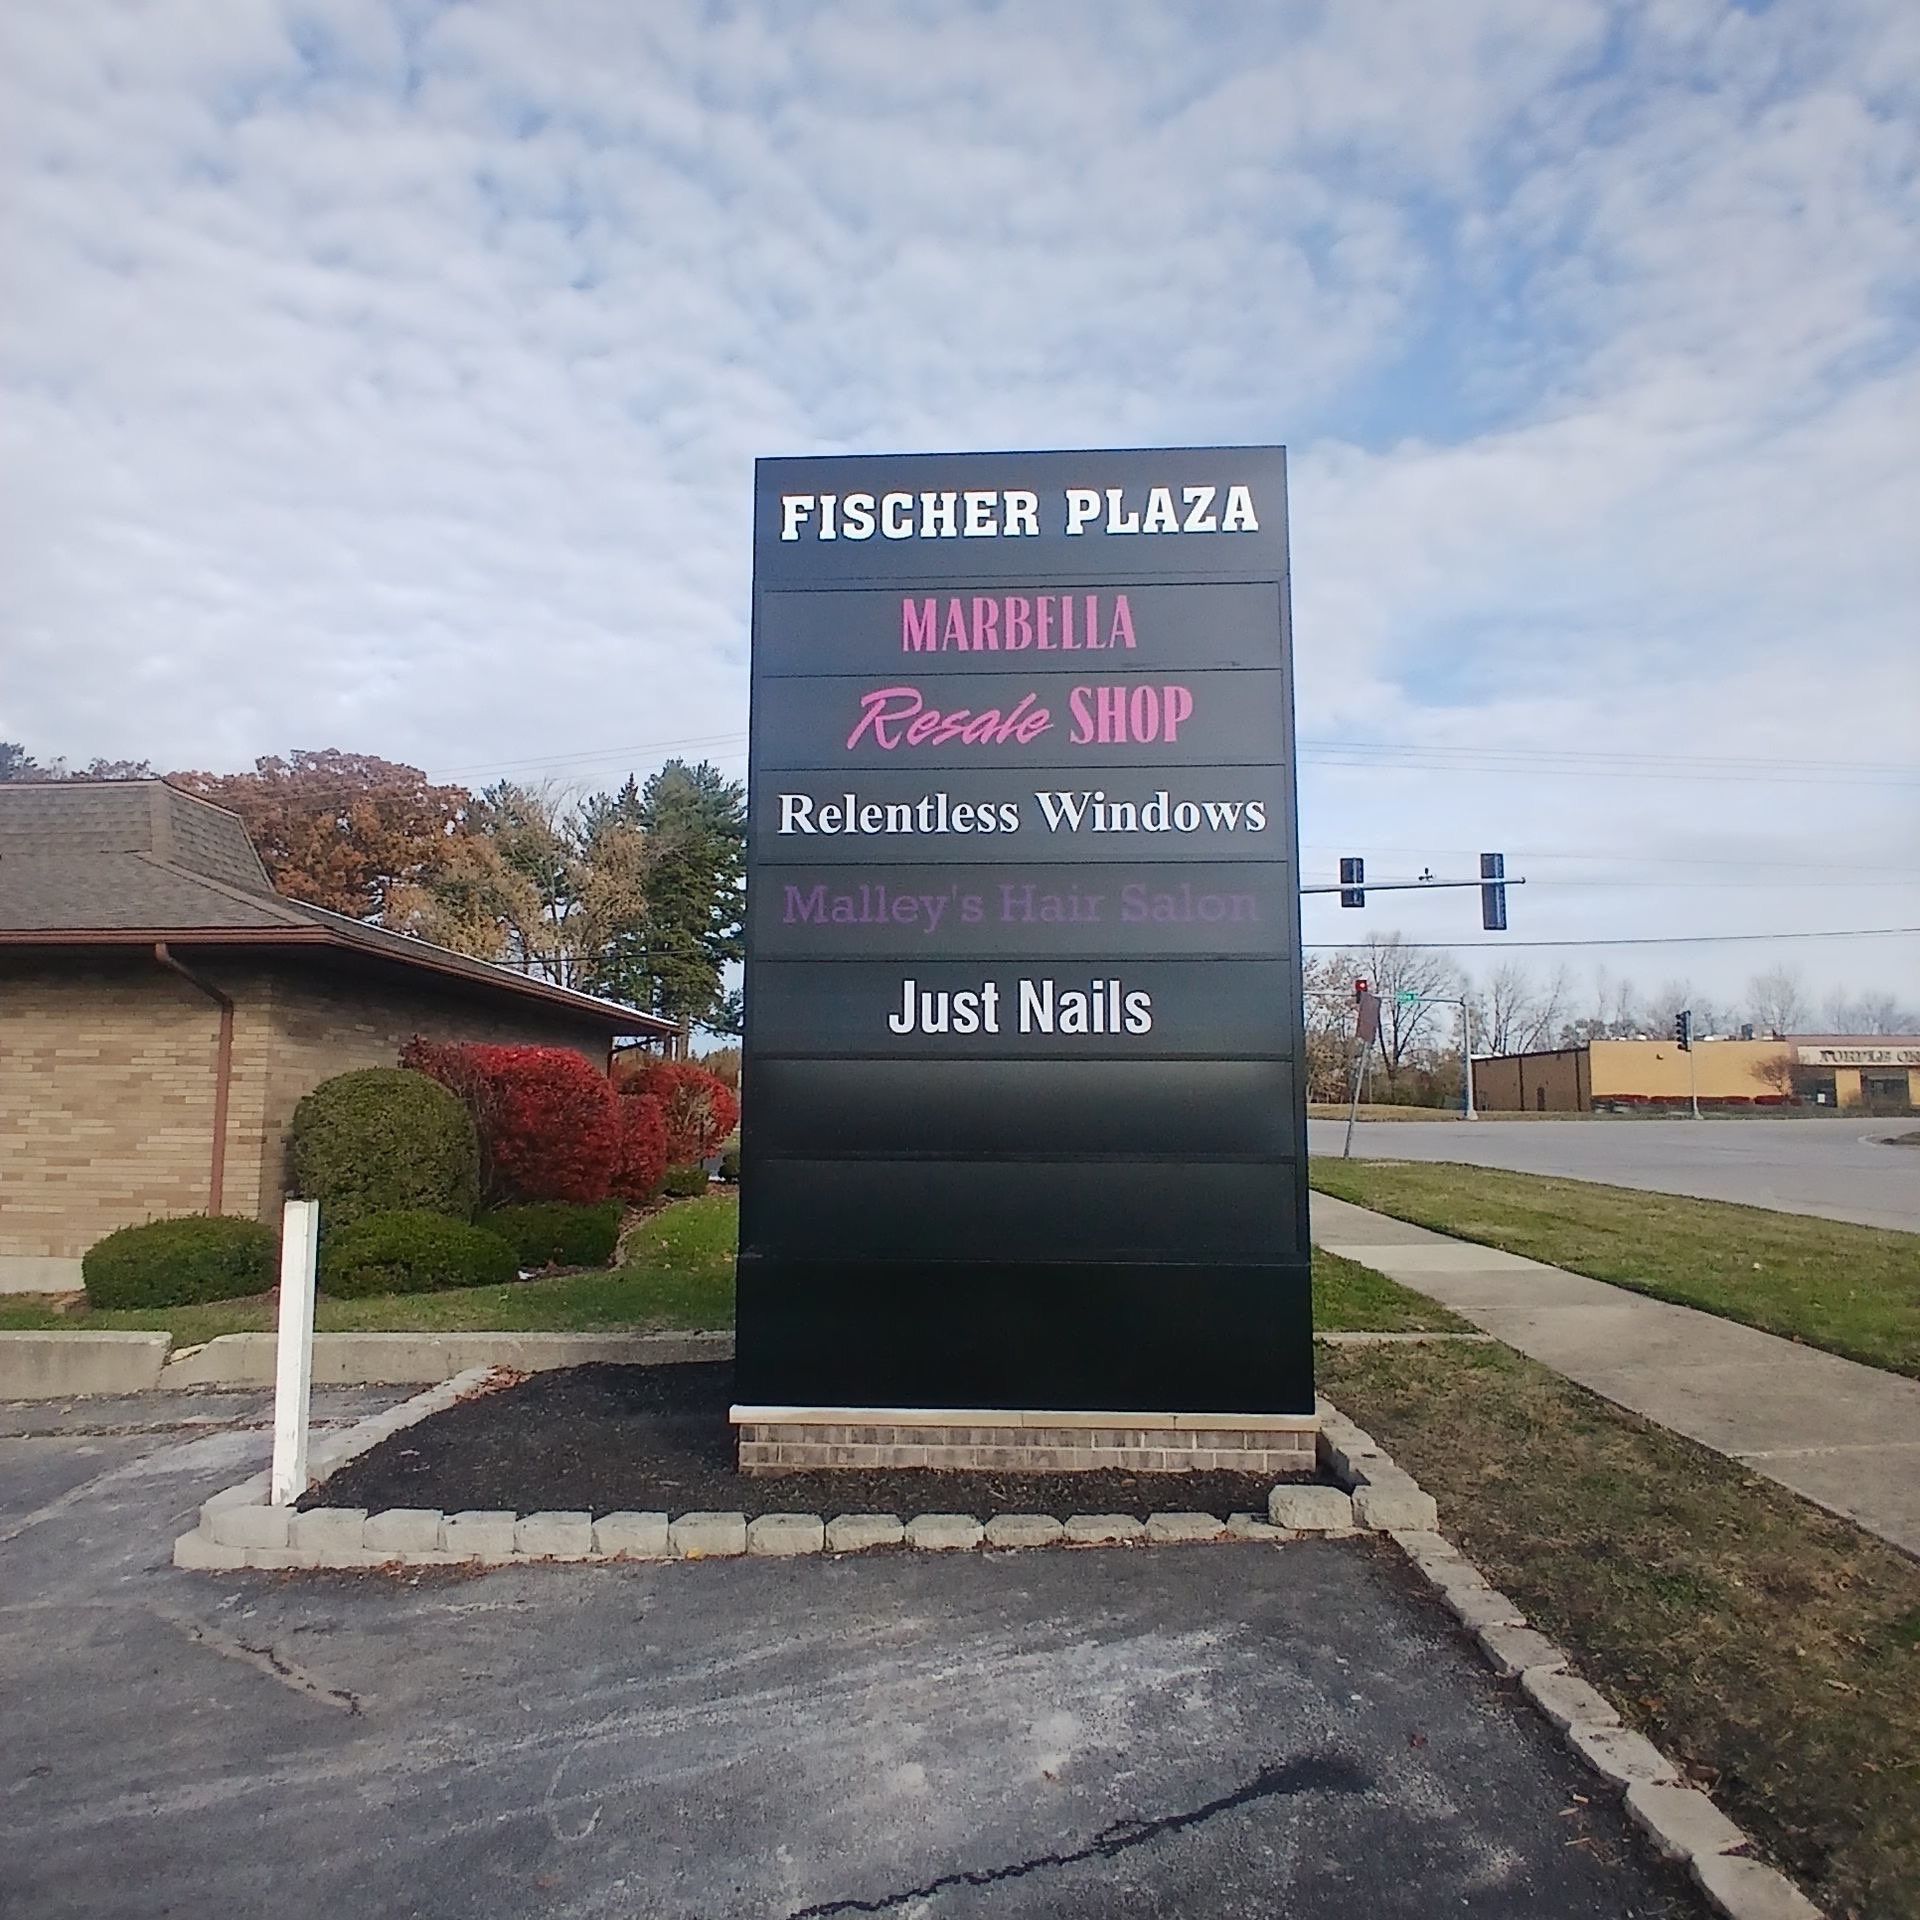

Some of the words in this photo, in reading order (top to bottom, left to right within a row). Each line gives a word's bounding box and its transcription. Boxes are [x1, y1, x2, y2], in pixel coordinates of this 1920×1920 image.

[780, 490, 1041, 542] FISCHER
[1064, 485, 1260, 536] PLAZA
[901, 594, 1137, 653] MARBELLA
[846, 686, 1055, 751] Resale
[1069, 685, 1194, 745] SHOP
[777, 793, 1020, 835] Relentless
[1035, 791, 1267, 833] Windows
[782, 882, 985, 934] Malley's
[999, 883, 1106, 924] Hair
[1120, 882, 1261, 923] Salon
[887, 978, 1000, 1035] Just
[1018, 978, 1154, 1034] Nails
